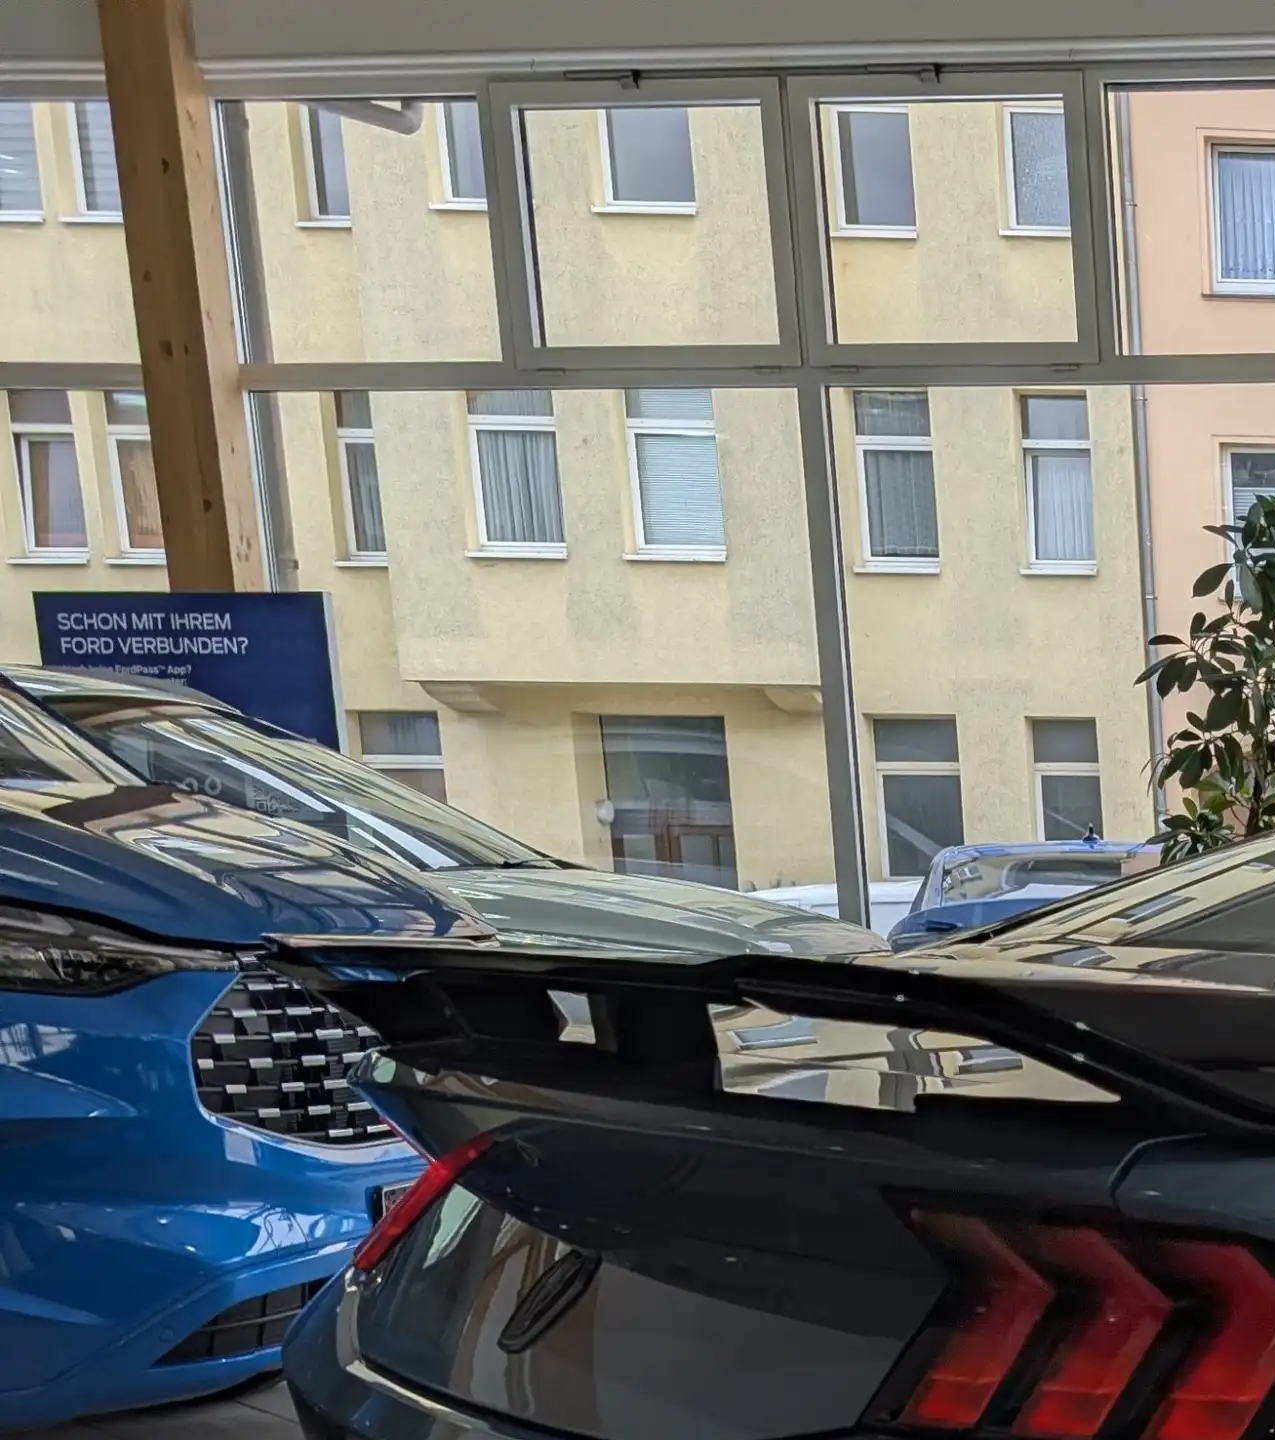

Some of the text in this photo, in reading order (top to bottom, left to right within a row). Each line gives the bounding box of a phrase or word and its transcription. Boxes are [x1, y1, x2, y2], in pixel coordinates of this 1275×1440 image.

[57, 612, 232, 631] SCHON MIT IHREM
[60, 636, 249, 655] FORD VERBUNDEN?
[167, 664, 192, 676] App?
